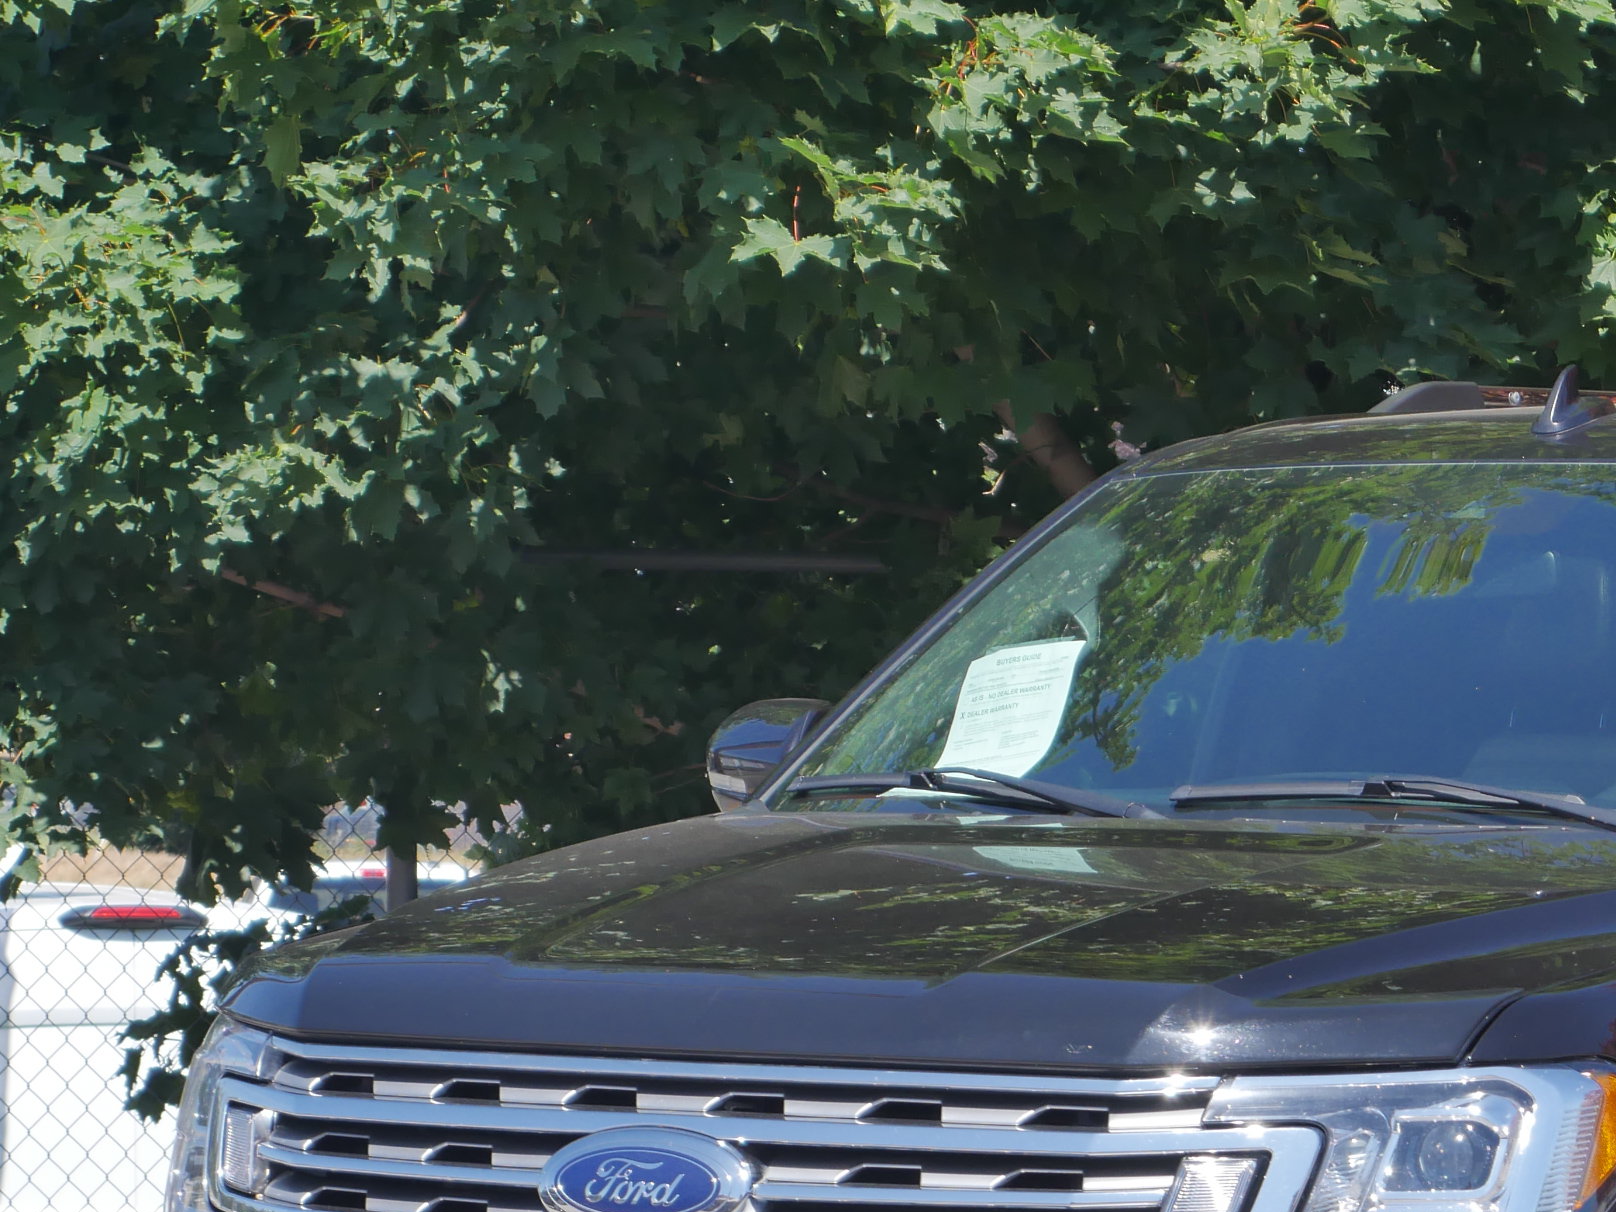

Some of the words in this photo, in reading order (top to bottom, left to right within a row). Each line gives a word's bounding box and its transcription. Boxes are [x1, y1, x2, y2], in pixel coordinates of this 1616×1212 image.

[1019, 683, 1051, 694] WARRANTY
[967, 708, 989, 718] DEALER
[989, 702, 1019, 713] WARRANTY
[584, 1156, 685, 1208] Ford
